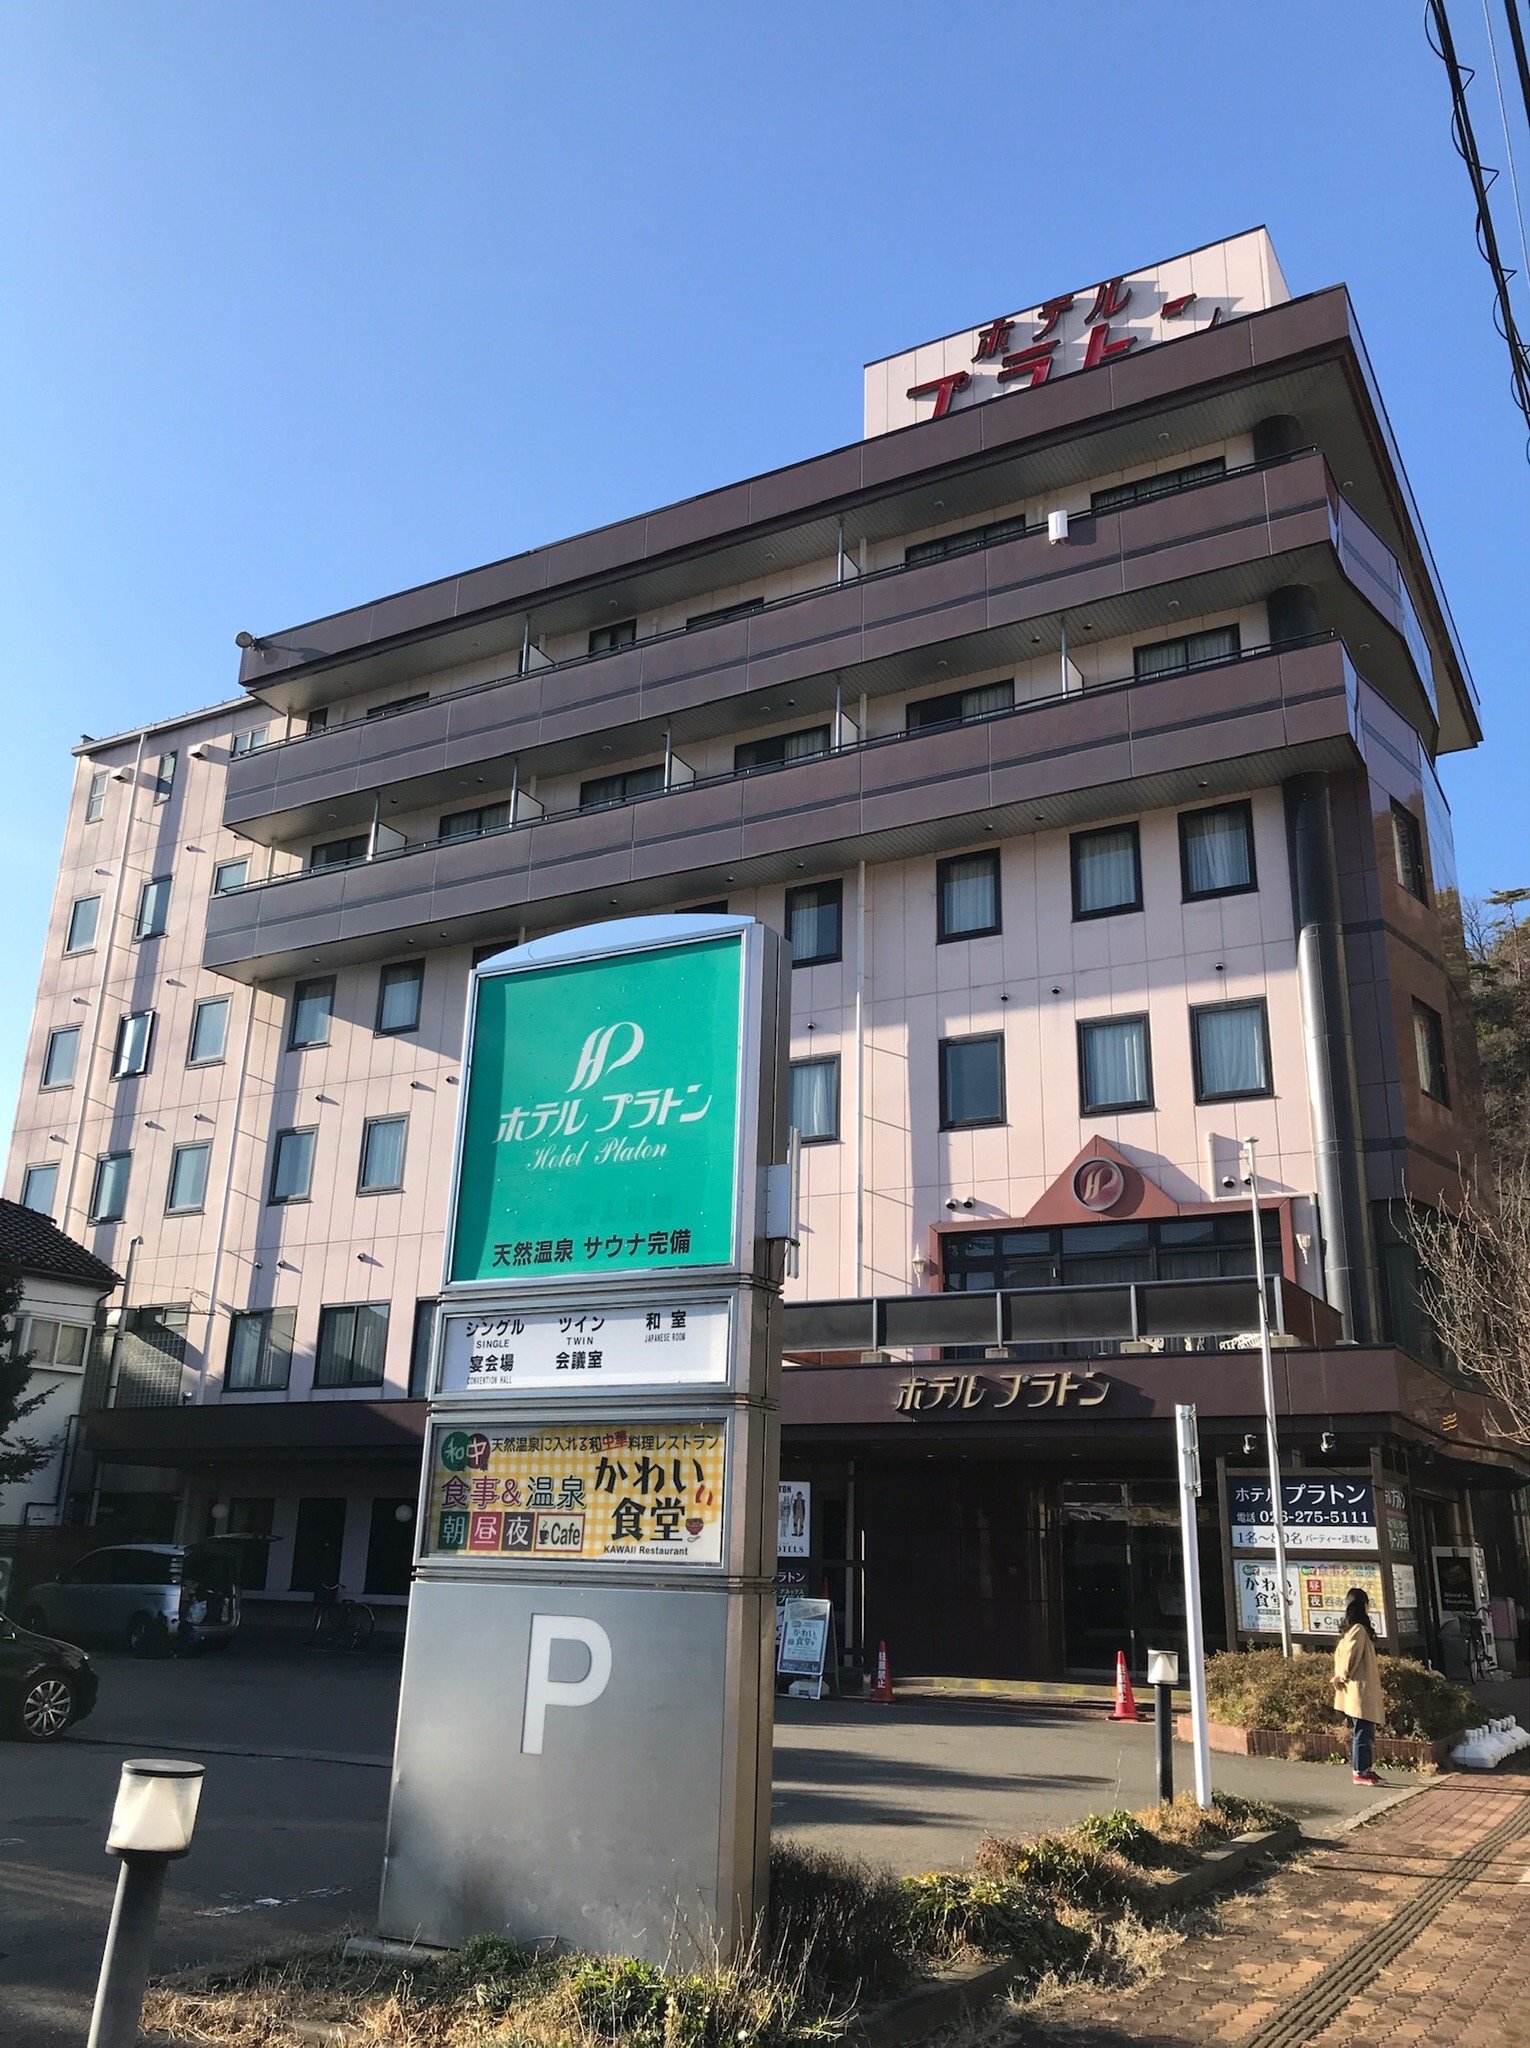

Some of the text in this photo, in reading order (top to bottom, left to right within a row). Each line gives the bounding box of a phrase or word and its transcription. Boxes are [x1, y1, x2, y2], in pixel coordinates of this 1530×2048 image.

[971, 277, 1132, 364] ホテル
[492, 1084, 712, 1144] ホテル プラトン
[527, 1136, 667, 1171] Hotel Platon
[492, 1228, 691, 1267] 天然温泉 サウナ完備
[466, 1319, 525, 1338] シングル
[559, 1316, 605, 1333] ツイン
[476, 1339, 510, 1349] SINGLE
[567, 1336, 594, 1345] TWIN
[470, 1353, 514, 1373] 宴会場
[556, 1350, 603, 1370] 会議室
[896, 1372, 1110, 1410] ホテル プラトン
[1286, 1483, 1366, 1505] プラトン
[442, 1515, 581, 1546] 朝 昼 夜 Cafe
[611, 1497, 685, 1541] 食堂
[640, 1545, 689, 1556] Restaurant
[521, 1613, 612, 1755] P
